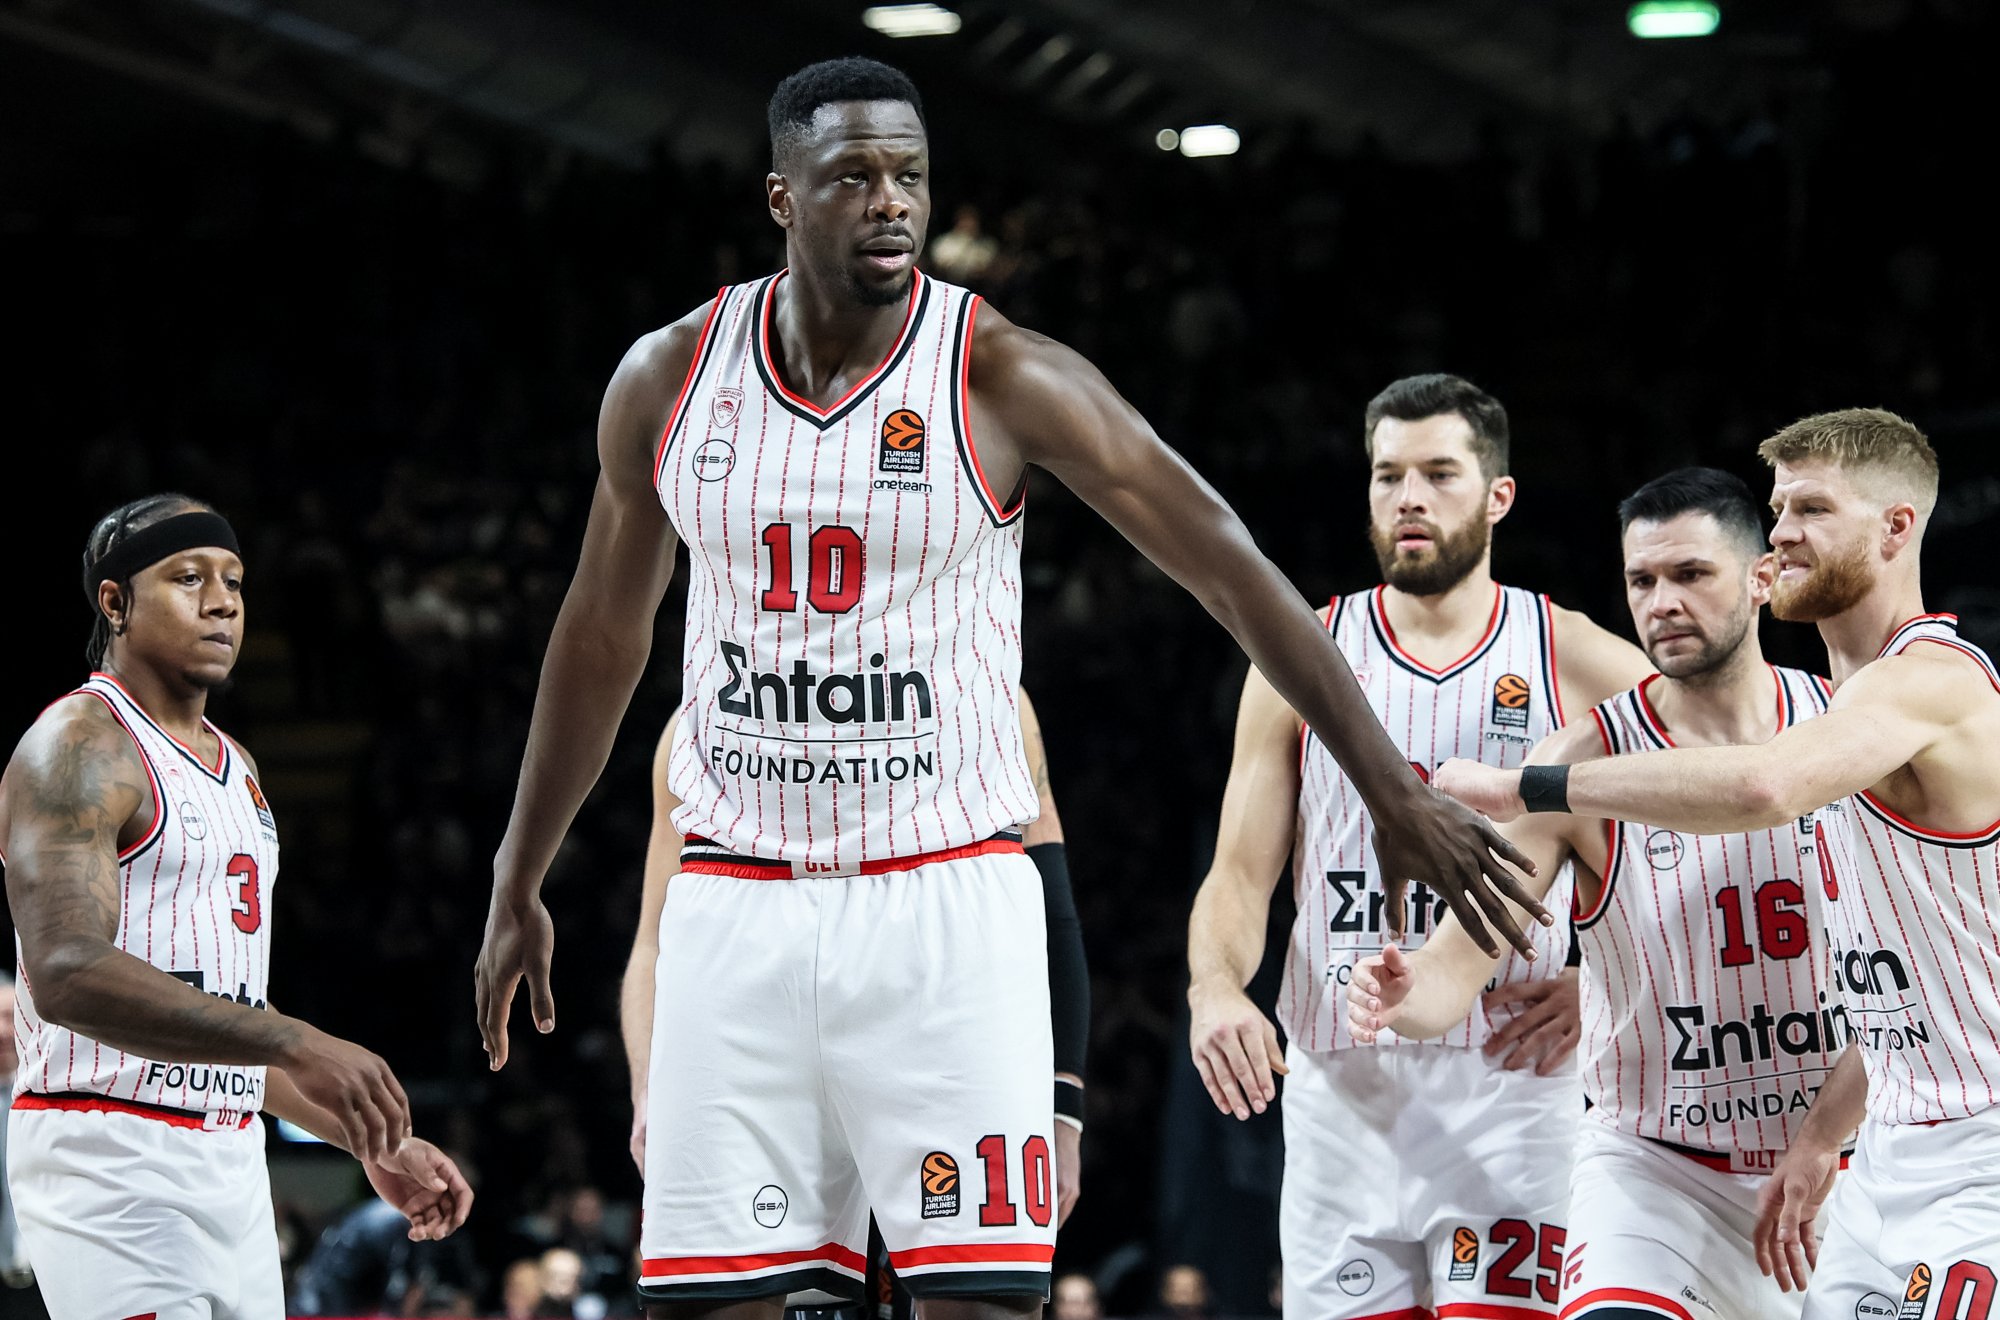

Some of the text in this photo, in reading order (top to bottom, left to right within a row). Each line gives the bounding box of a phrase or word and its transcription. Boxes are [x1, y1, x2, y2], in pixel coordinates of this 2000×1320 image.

[696, 455, 732, 464] GSA
[884, 450, 920, 458] TURKISH
[884, 457, 920, 465] AIRLINES
[883, 463, 920, 471] EuroLeague
[873, 480, 933, 493] oneteam
[761, 523, 864, 614] 10
[711, 746, 933, 784] FOUNDATION
[226, 853, 263, 935] 3
[1715, 879, 1809, 968] 16
[976, 1134, 1053, 1228] 10
[925, 1194, 957, 1203] TURKISH
[756, 1202, 785, 1211] GSA
[925, 1201, 957, 1210] AIRLINES
[1485, 1218, 1567, 1305] 25
[1860, 1306, 1895, 1317] GSA
